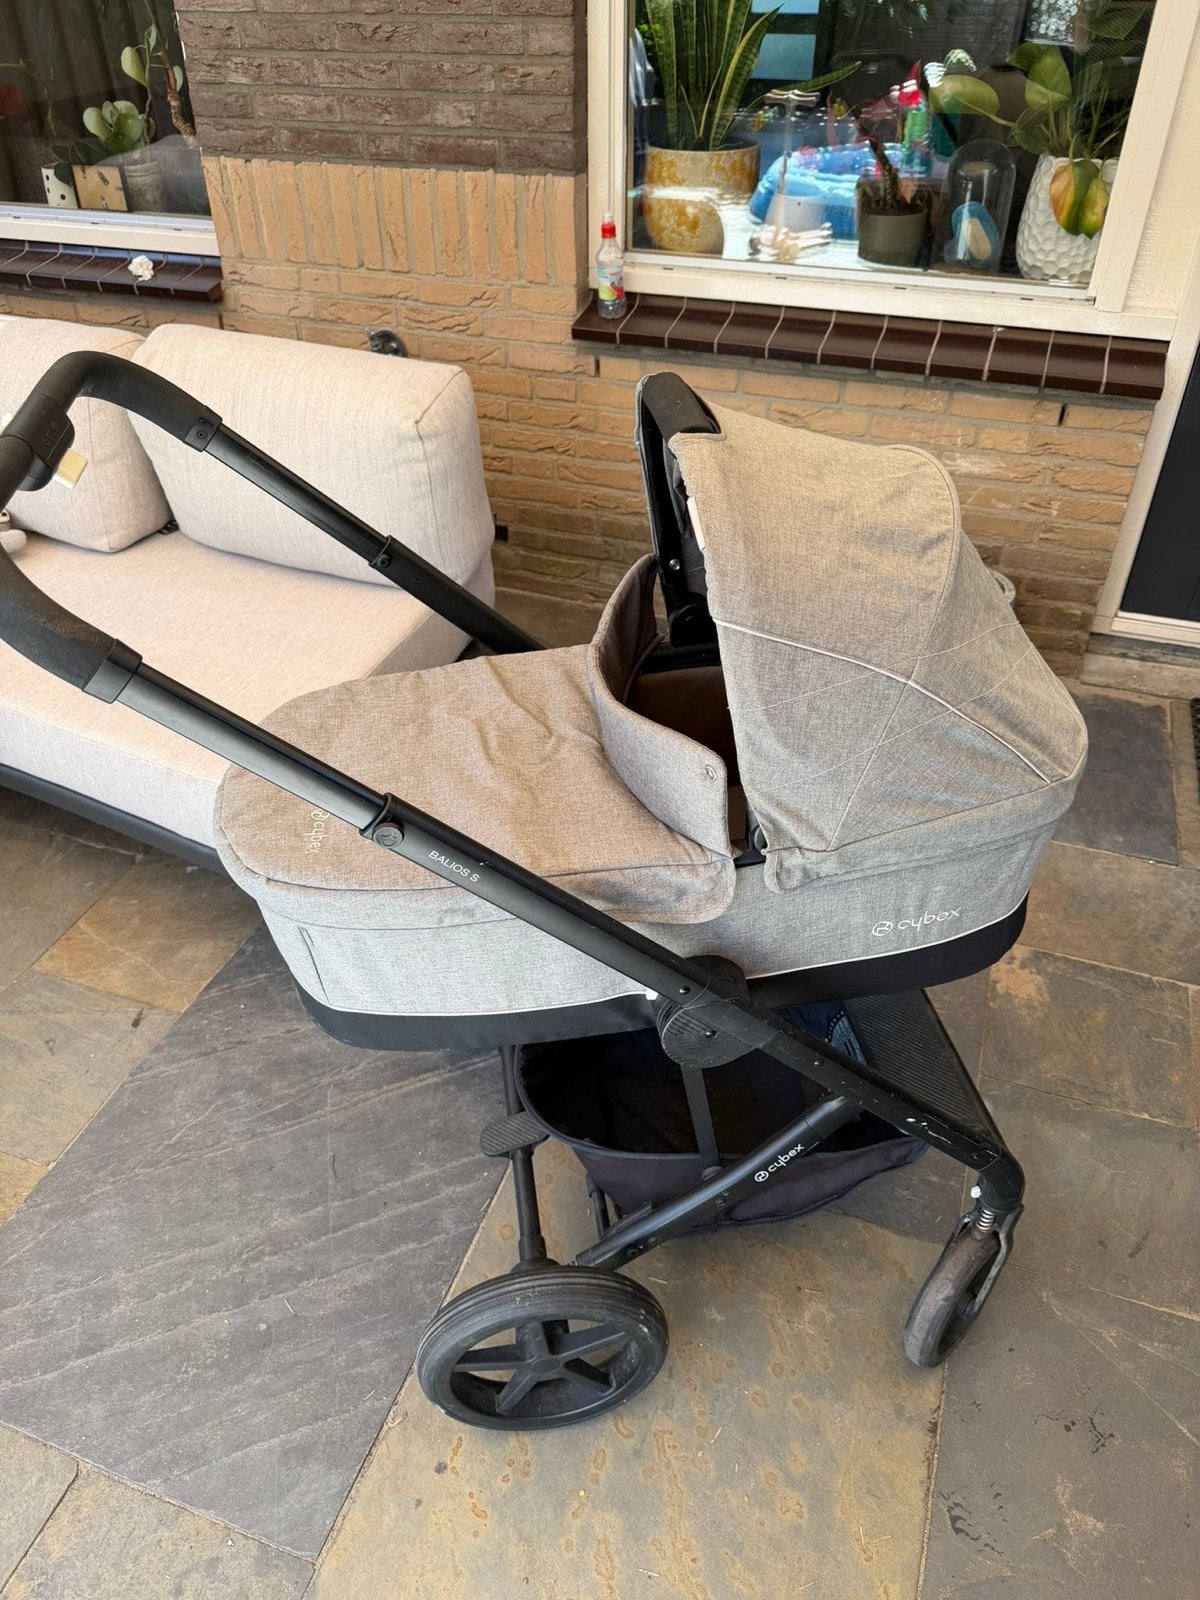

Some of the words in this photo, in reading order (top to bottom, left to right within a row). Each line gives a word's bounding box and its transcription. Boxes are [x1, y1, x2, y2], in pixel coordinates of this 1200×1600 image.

[304, 821, 330, 854] cybex
[428, 850, 471, 877] BALIOS
[470, 873, 480, 882] S
[897, 907, 961, 932] cybex
[767, 1143, 805, 1172] cybex
